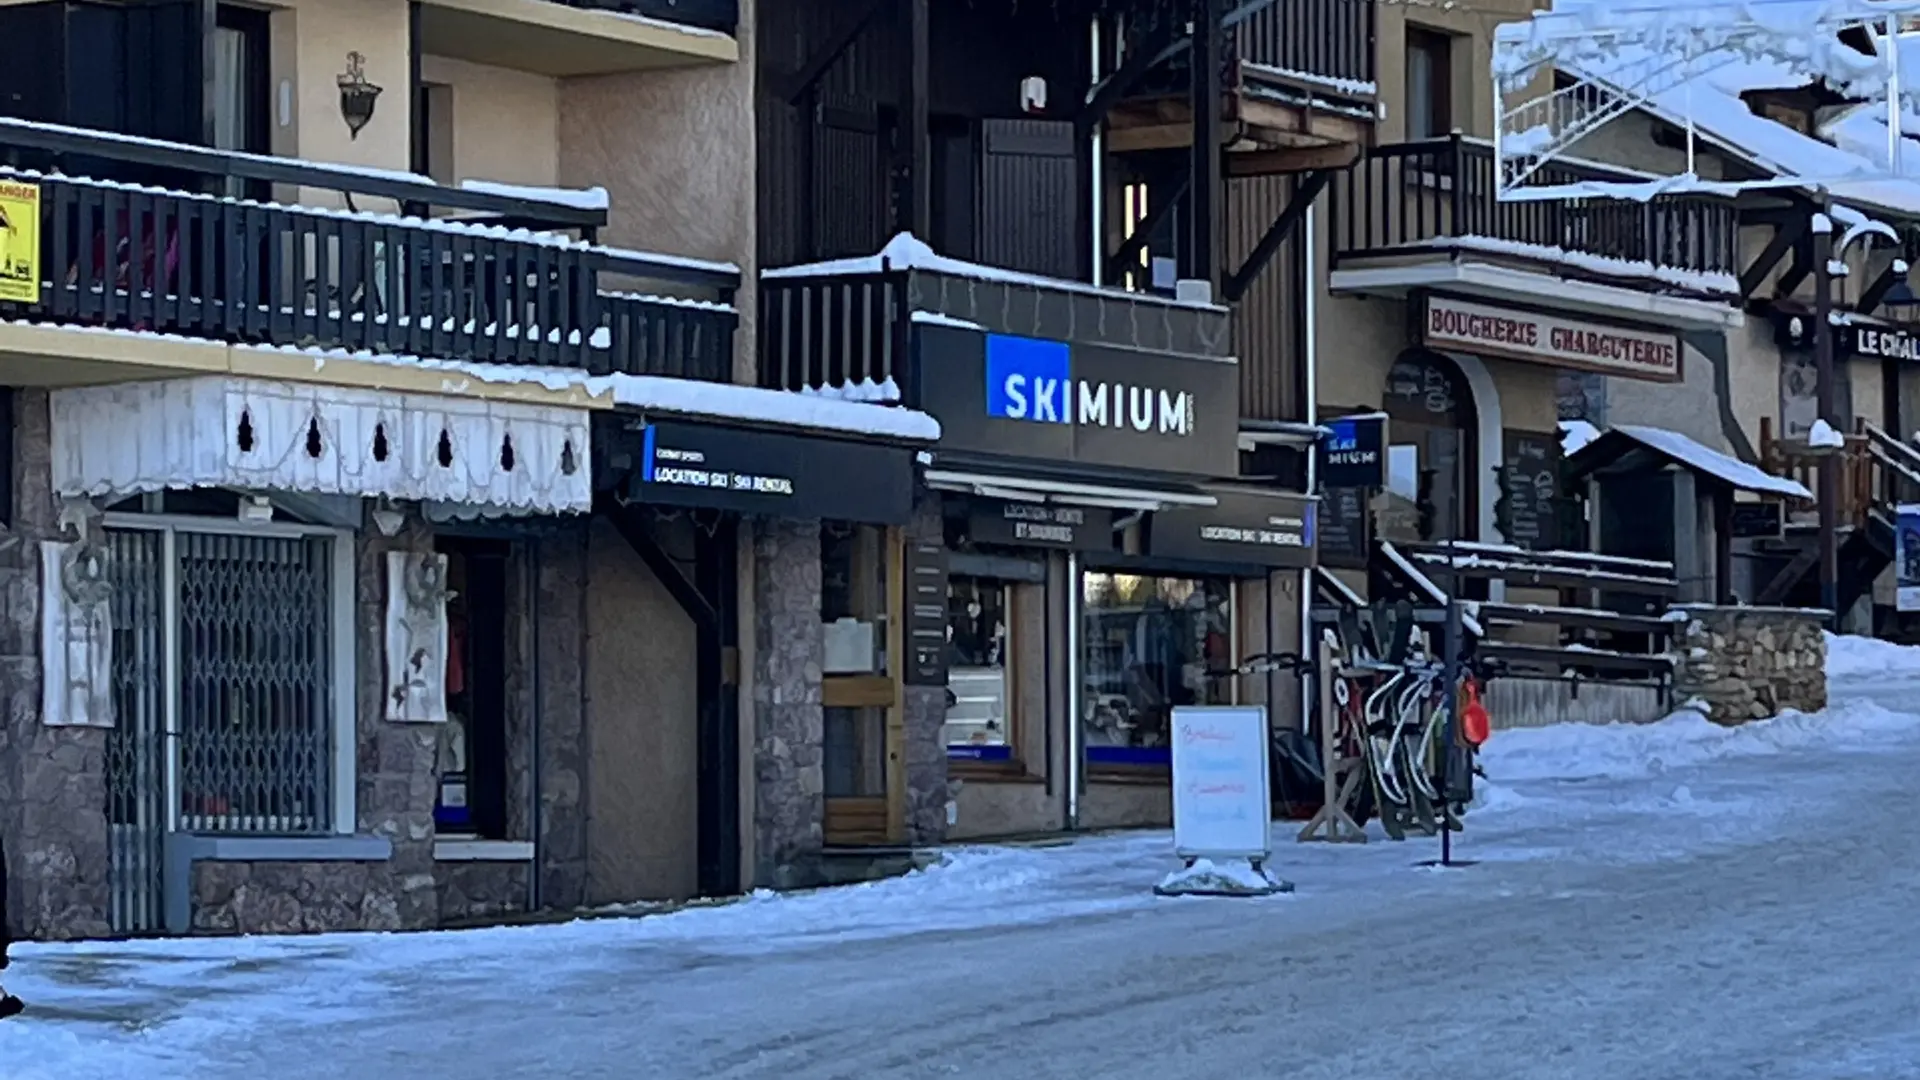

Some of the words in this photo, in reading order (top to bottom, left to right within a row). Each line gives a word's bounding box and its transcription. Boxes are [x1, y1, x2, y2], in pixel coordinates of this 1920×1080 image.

[1858, 329, 1879, 354] LE
[1005, 373, 1186, 435] SKIMIUM
[655, 467, 708, 486] LOCATION
